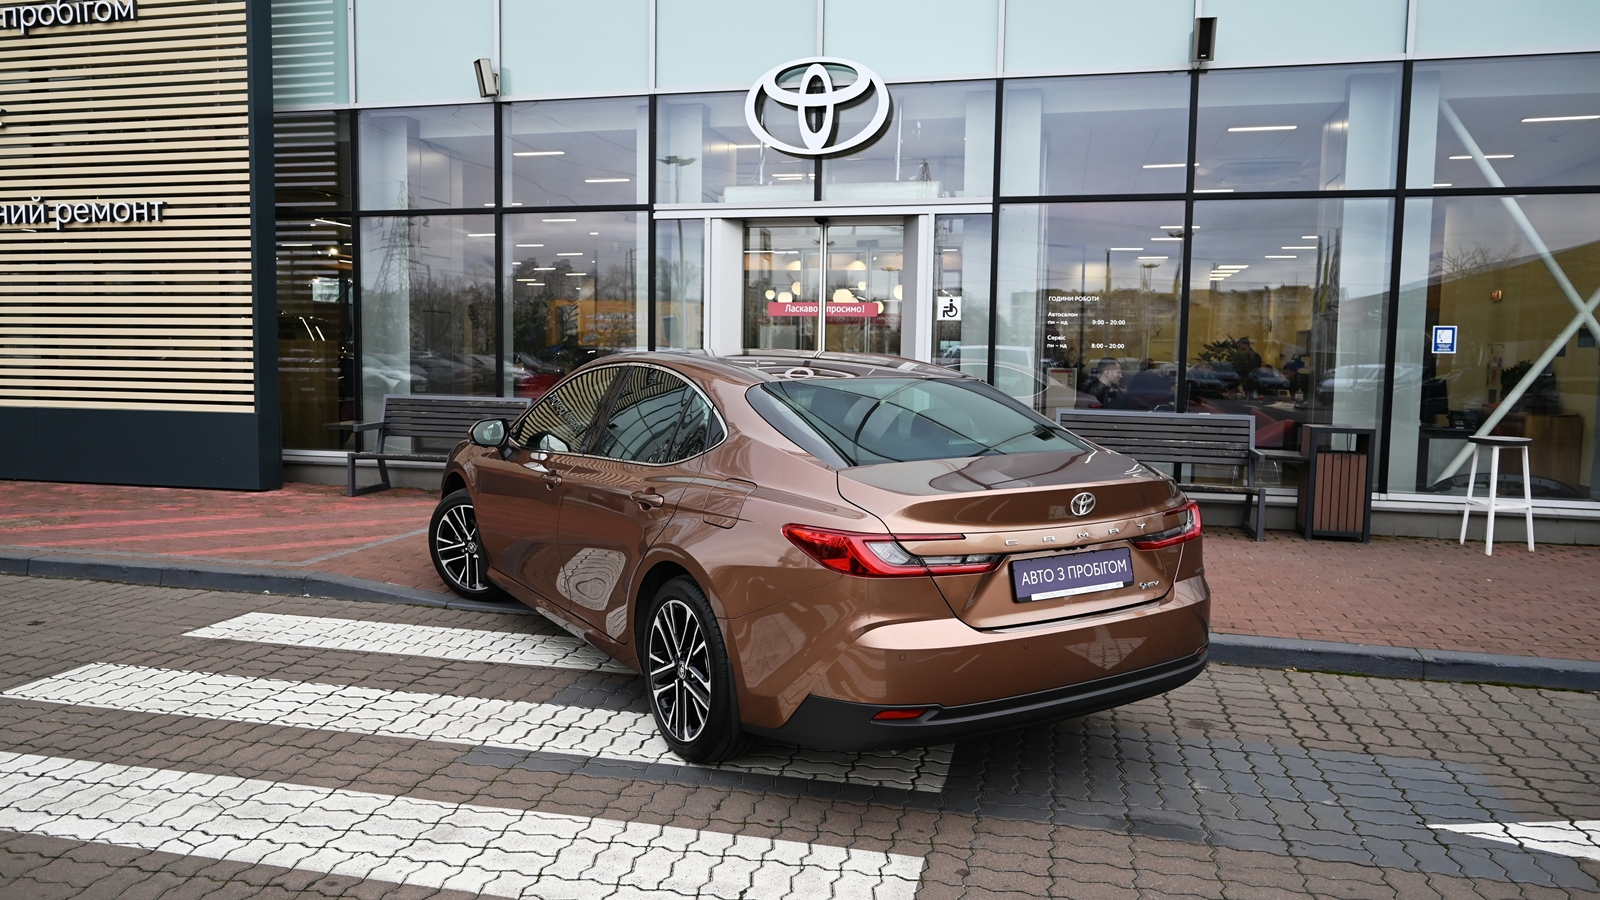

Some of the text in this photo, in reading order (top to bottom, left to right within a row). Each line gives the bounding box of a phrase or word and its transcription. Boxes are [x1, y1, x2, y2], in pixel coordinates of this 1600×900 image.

[2, 0, 134, 34] пробігом
[55, 201, 163, 231] ремонт
[784, 304, 865, 314] Ласкаво просимо!
[1004, 522, 1146, 546] CAMRY
[1021, 567, 1055, 586] АВТО
[1067, 558, 1128, 580] ПРОБІГОМ
